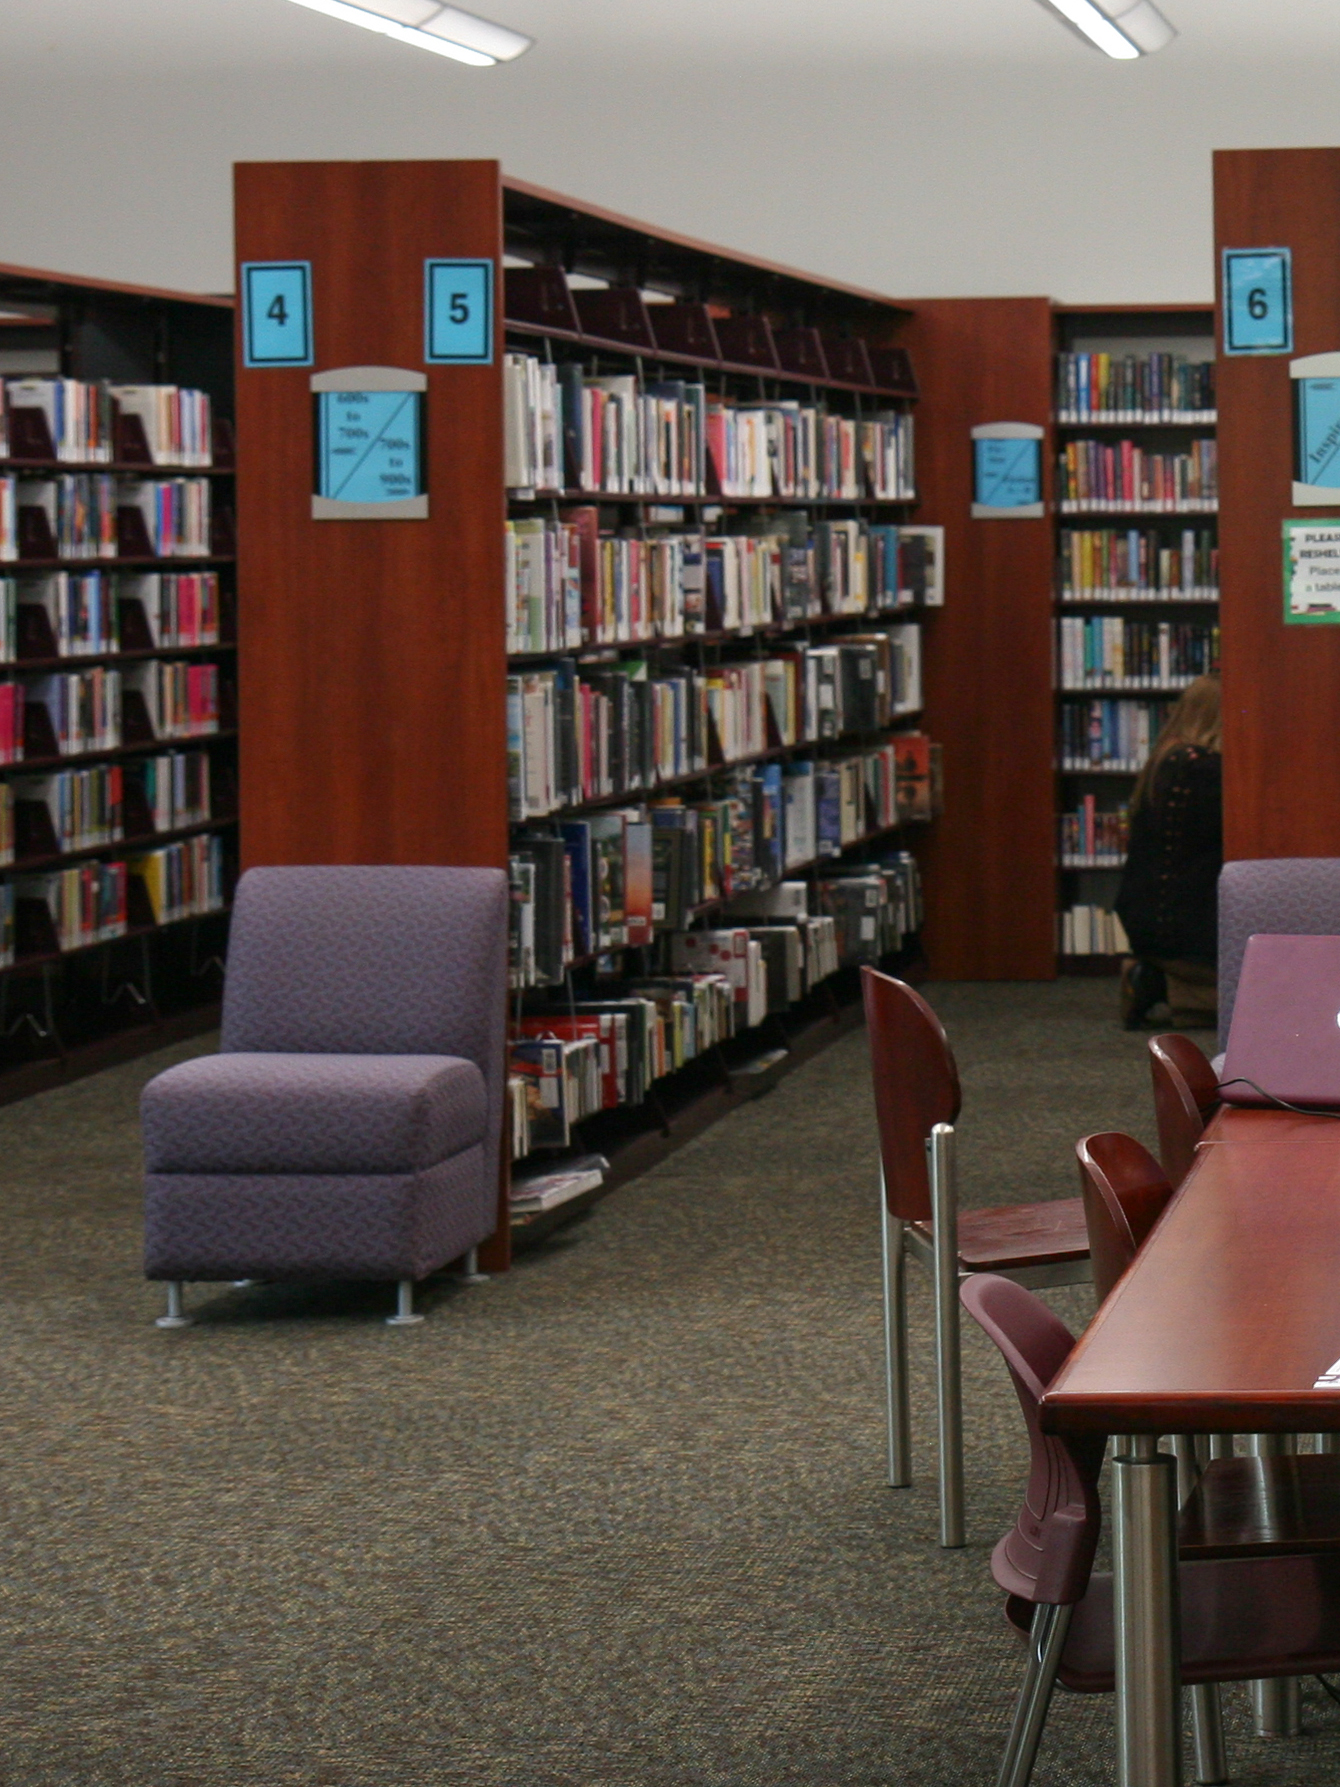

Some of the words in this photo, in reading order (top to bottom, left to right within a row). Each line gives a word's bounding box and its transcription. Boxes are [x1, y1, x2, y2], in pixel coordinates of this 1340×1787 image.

[267, 294, 289, 326] 4
[449, 293, 469, 324] 5
[1247, 288, 1269, 320] 6
